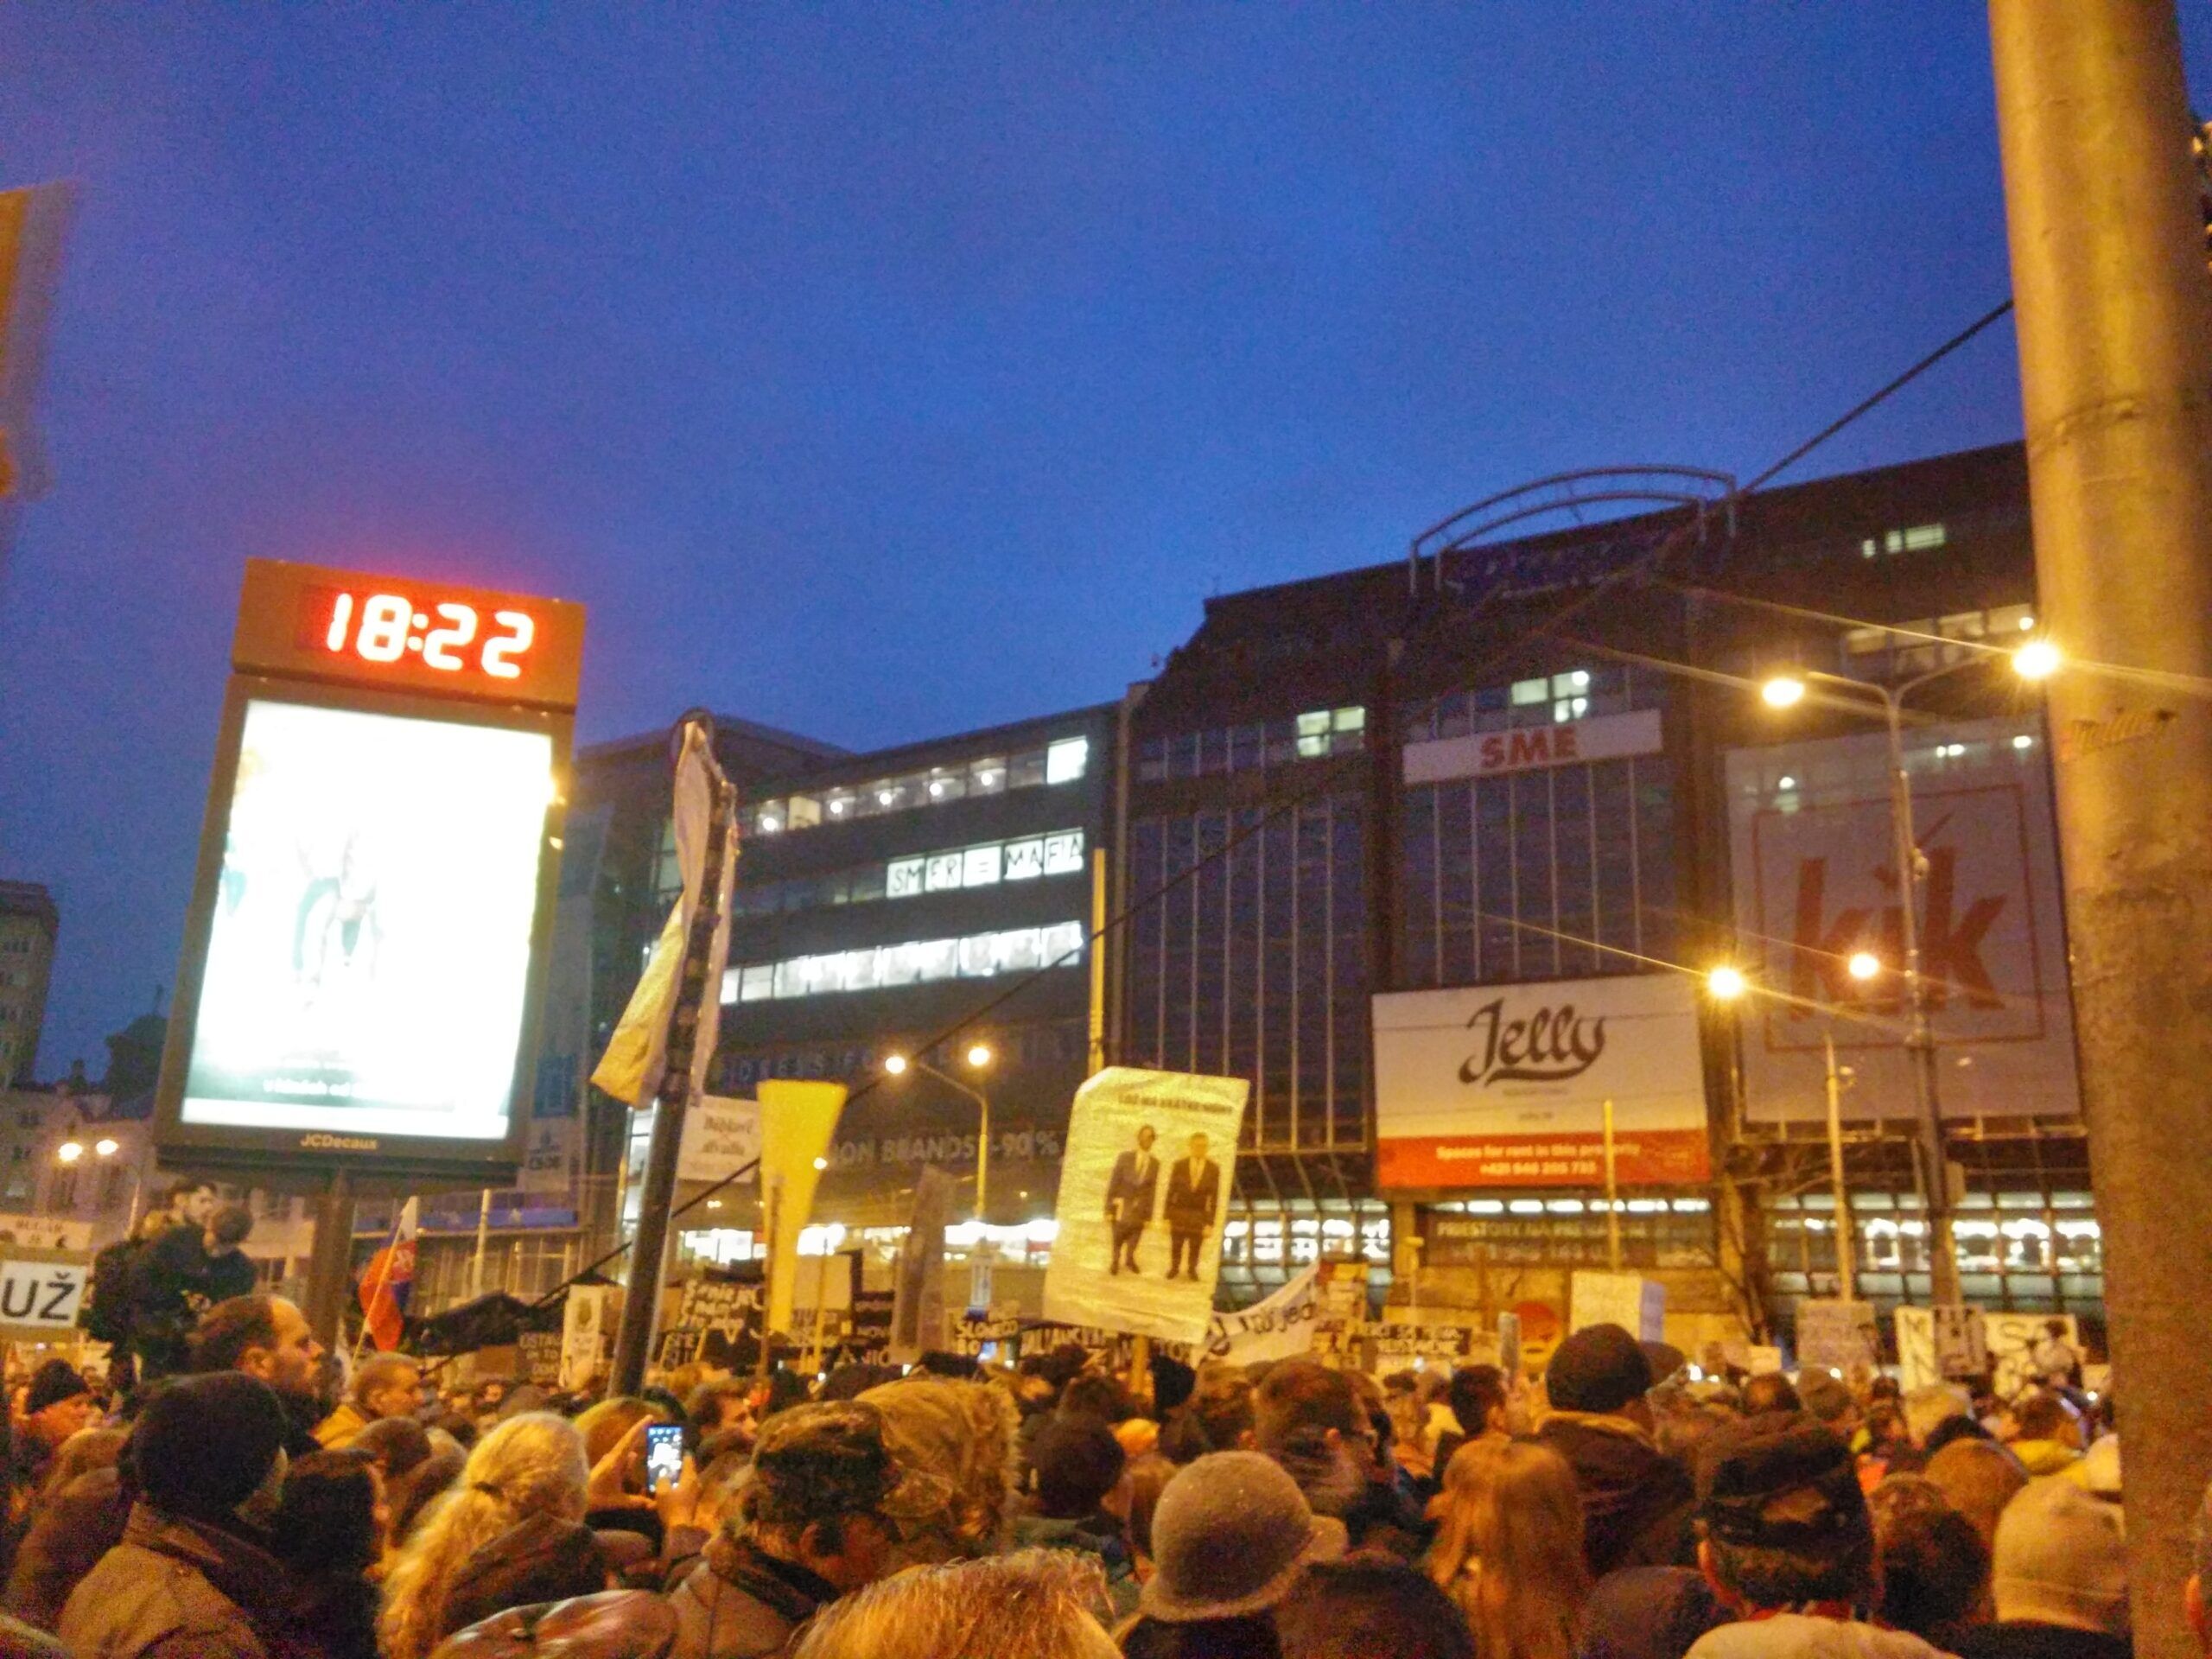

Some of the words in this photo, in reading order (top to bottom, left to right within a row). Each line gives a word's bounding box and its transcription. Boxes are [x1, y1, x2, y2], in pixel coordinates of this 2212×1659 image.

[327, 593, 535, 679] 18:22
[1480, 726, 1576, 768] SME
[893, 859, 957, 893] SMER
[1006, 835, 1082, 868] MAFIA
[1459, 997, 1606, 1087] Jelly
[299, 1133, 378, 1150] JCDecaux
[1579, 1142, 1641, 1158] proerty
[2, 1270, 76, 1320] UŽ
